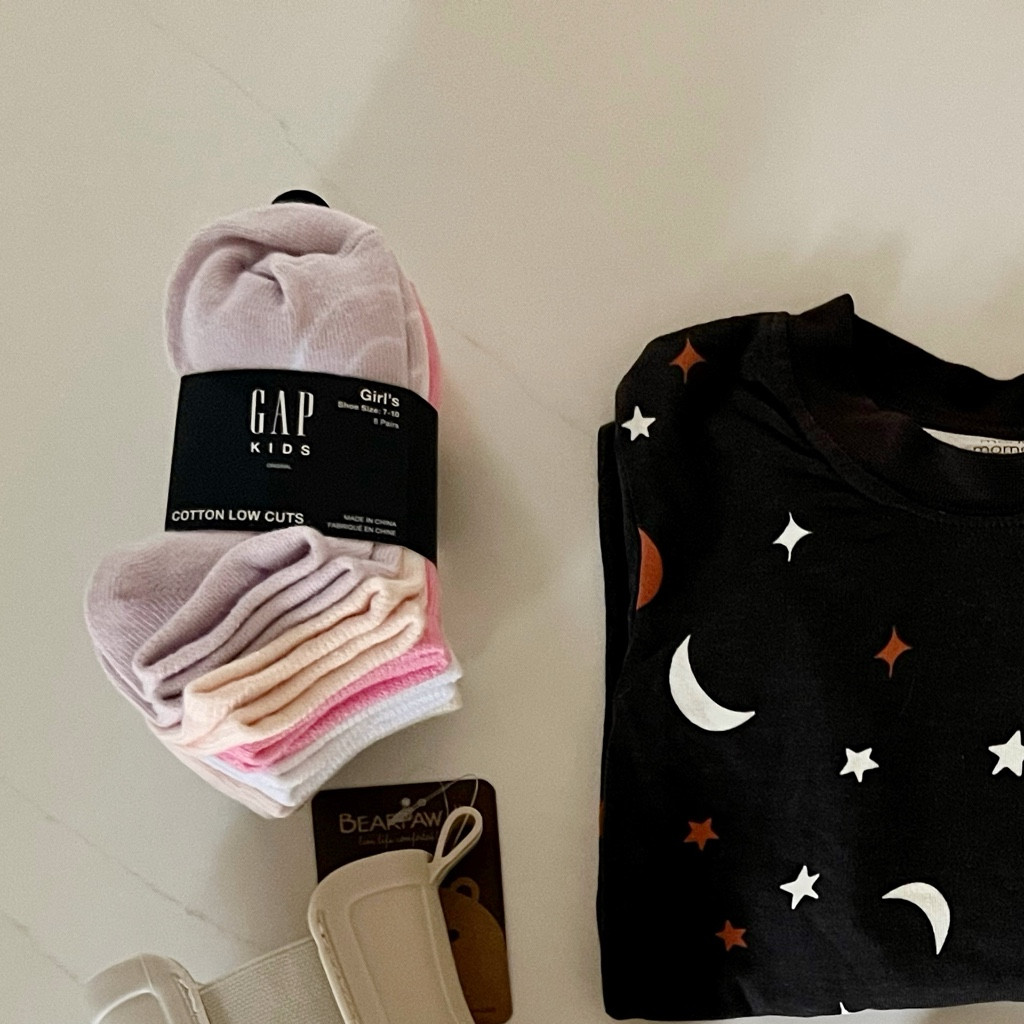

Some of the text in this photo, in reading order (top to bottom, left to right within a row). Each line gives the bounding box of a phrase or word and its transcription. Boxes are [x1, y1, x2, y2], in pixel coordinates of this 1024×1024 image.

[360, 388, 400, 407] Girl's
[251, 388, 314, 437] GAP
[338, 400, 359, 410] Shoe
[383, 408, 400, 418] 7-10
[250, 441, 311, 456] KIDS
[171, 509, 304, 524] COTTON LOW CUTS
[375, 518, 397, 527] CHINA
